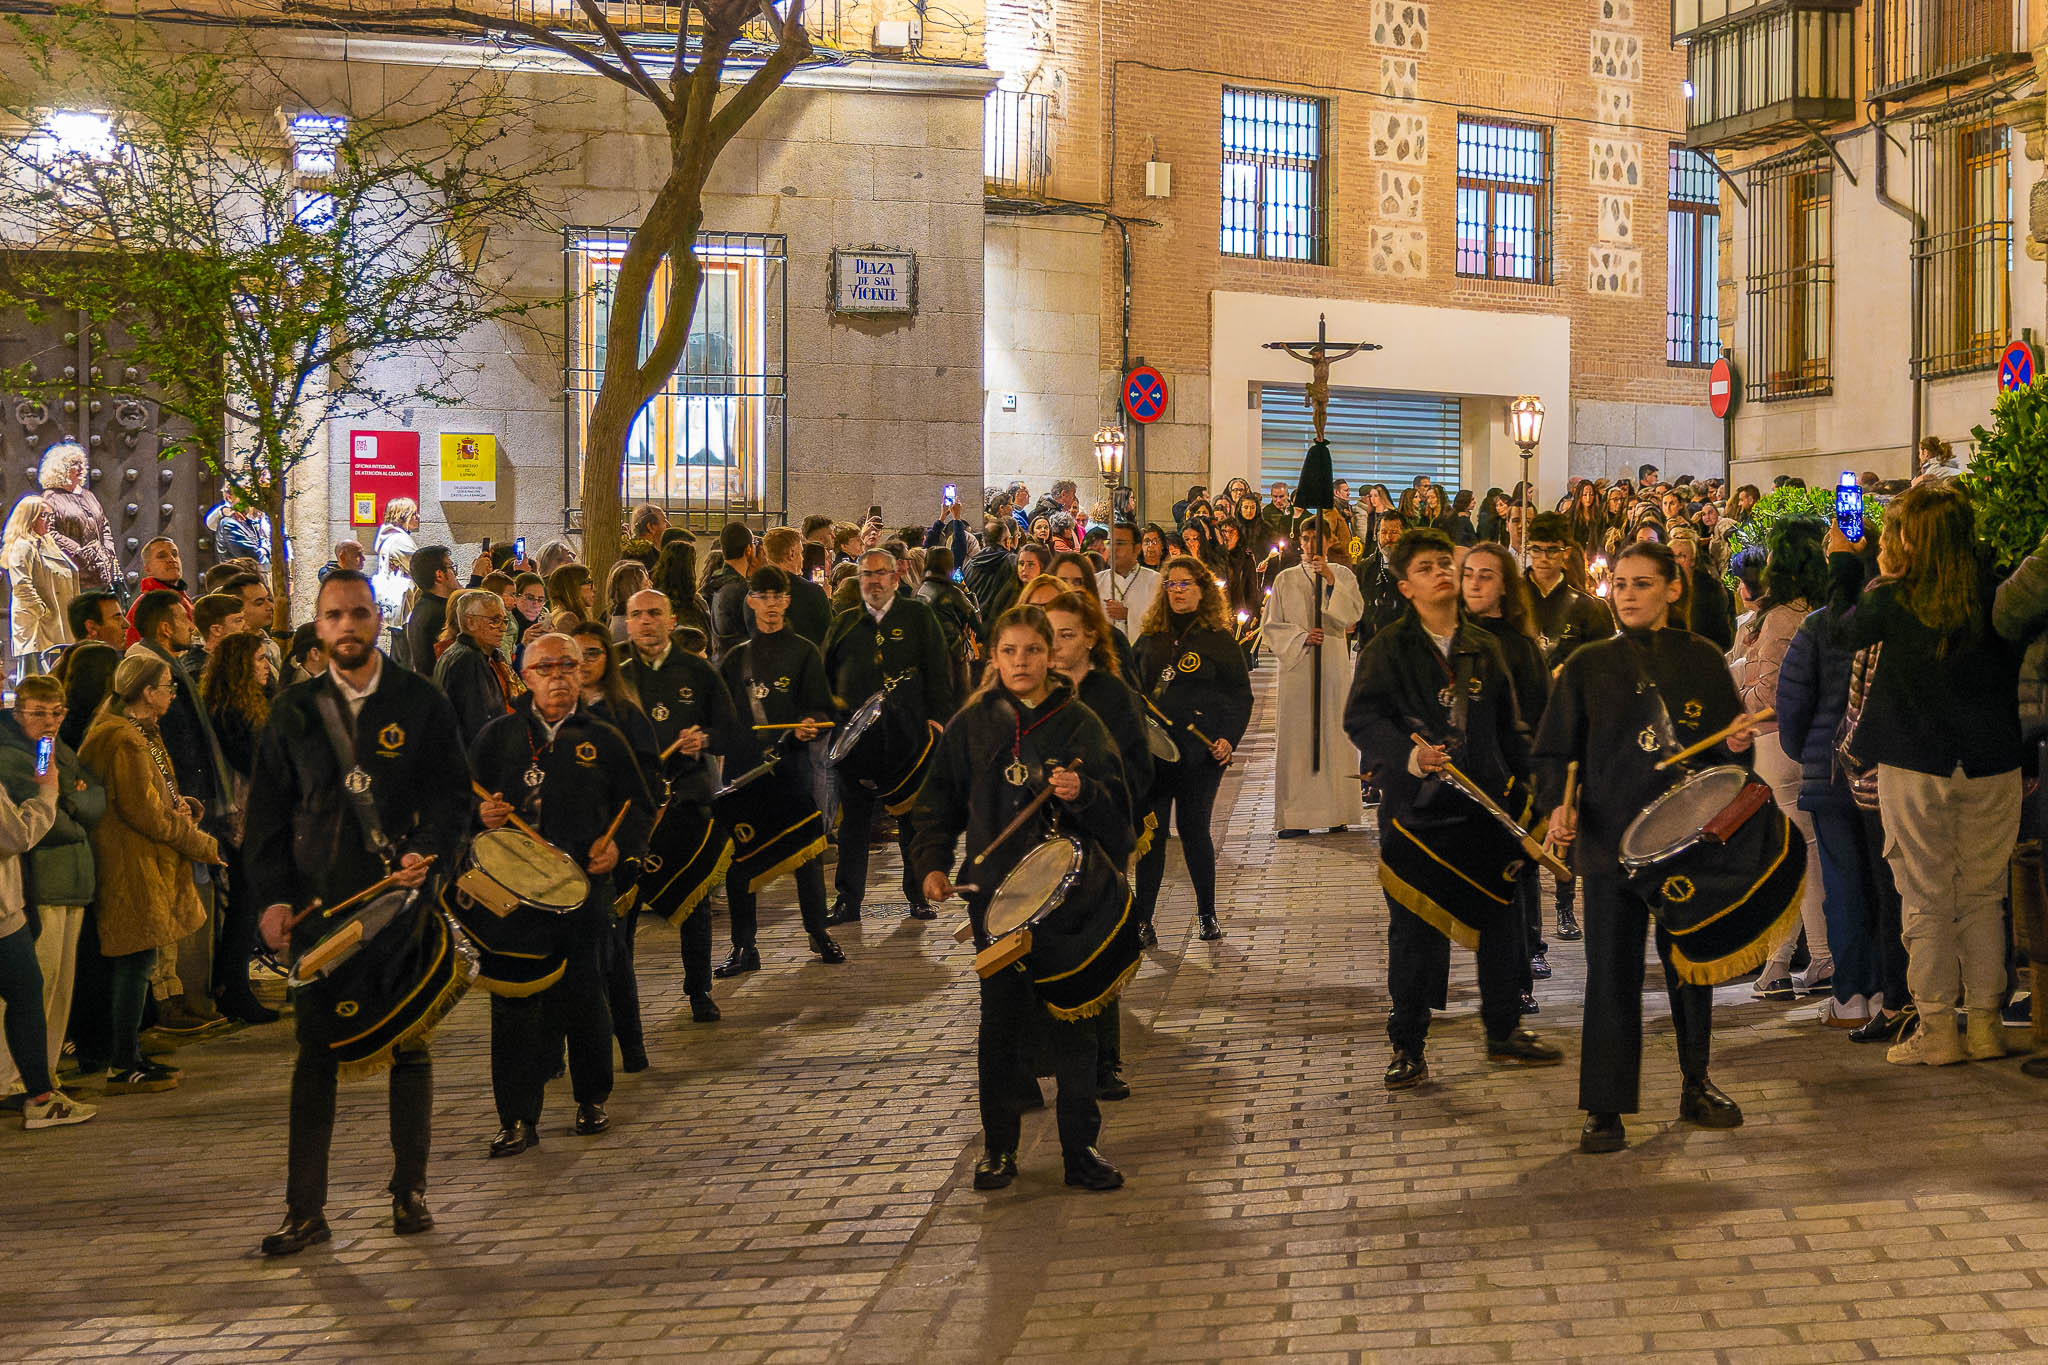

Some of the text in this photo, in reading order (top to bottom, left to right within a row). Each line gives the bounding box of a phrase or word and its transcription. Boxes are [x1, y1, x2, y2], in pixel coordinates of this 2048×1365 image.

[856, 259, 895, 275] PLAZA
[858, 277, 890, 286] DE SAN
[848, 285, 898, 301] VICENTE
